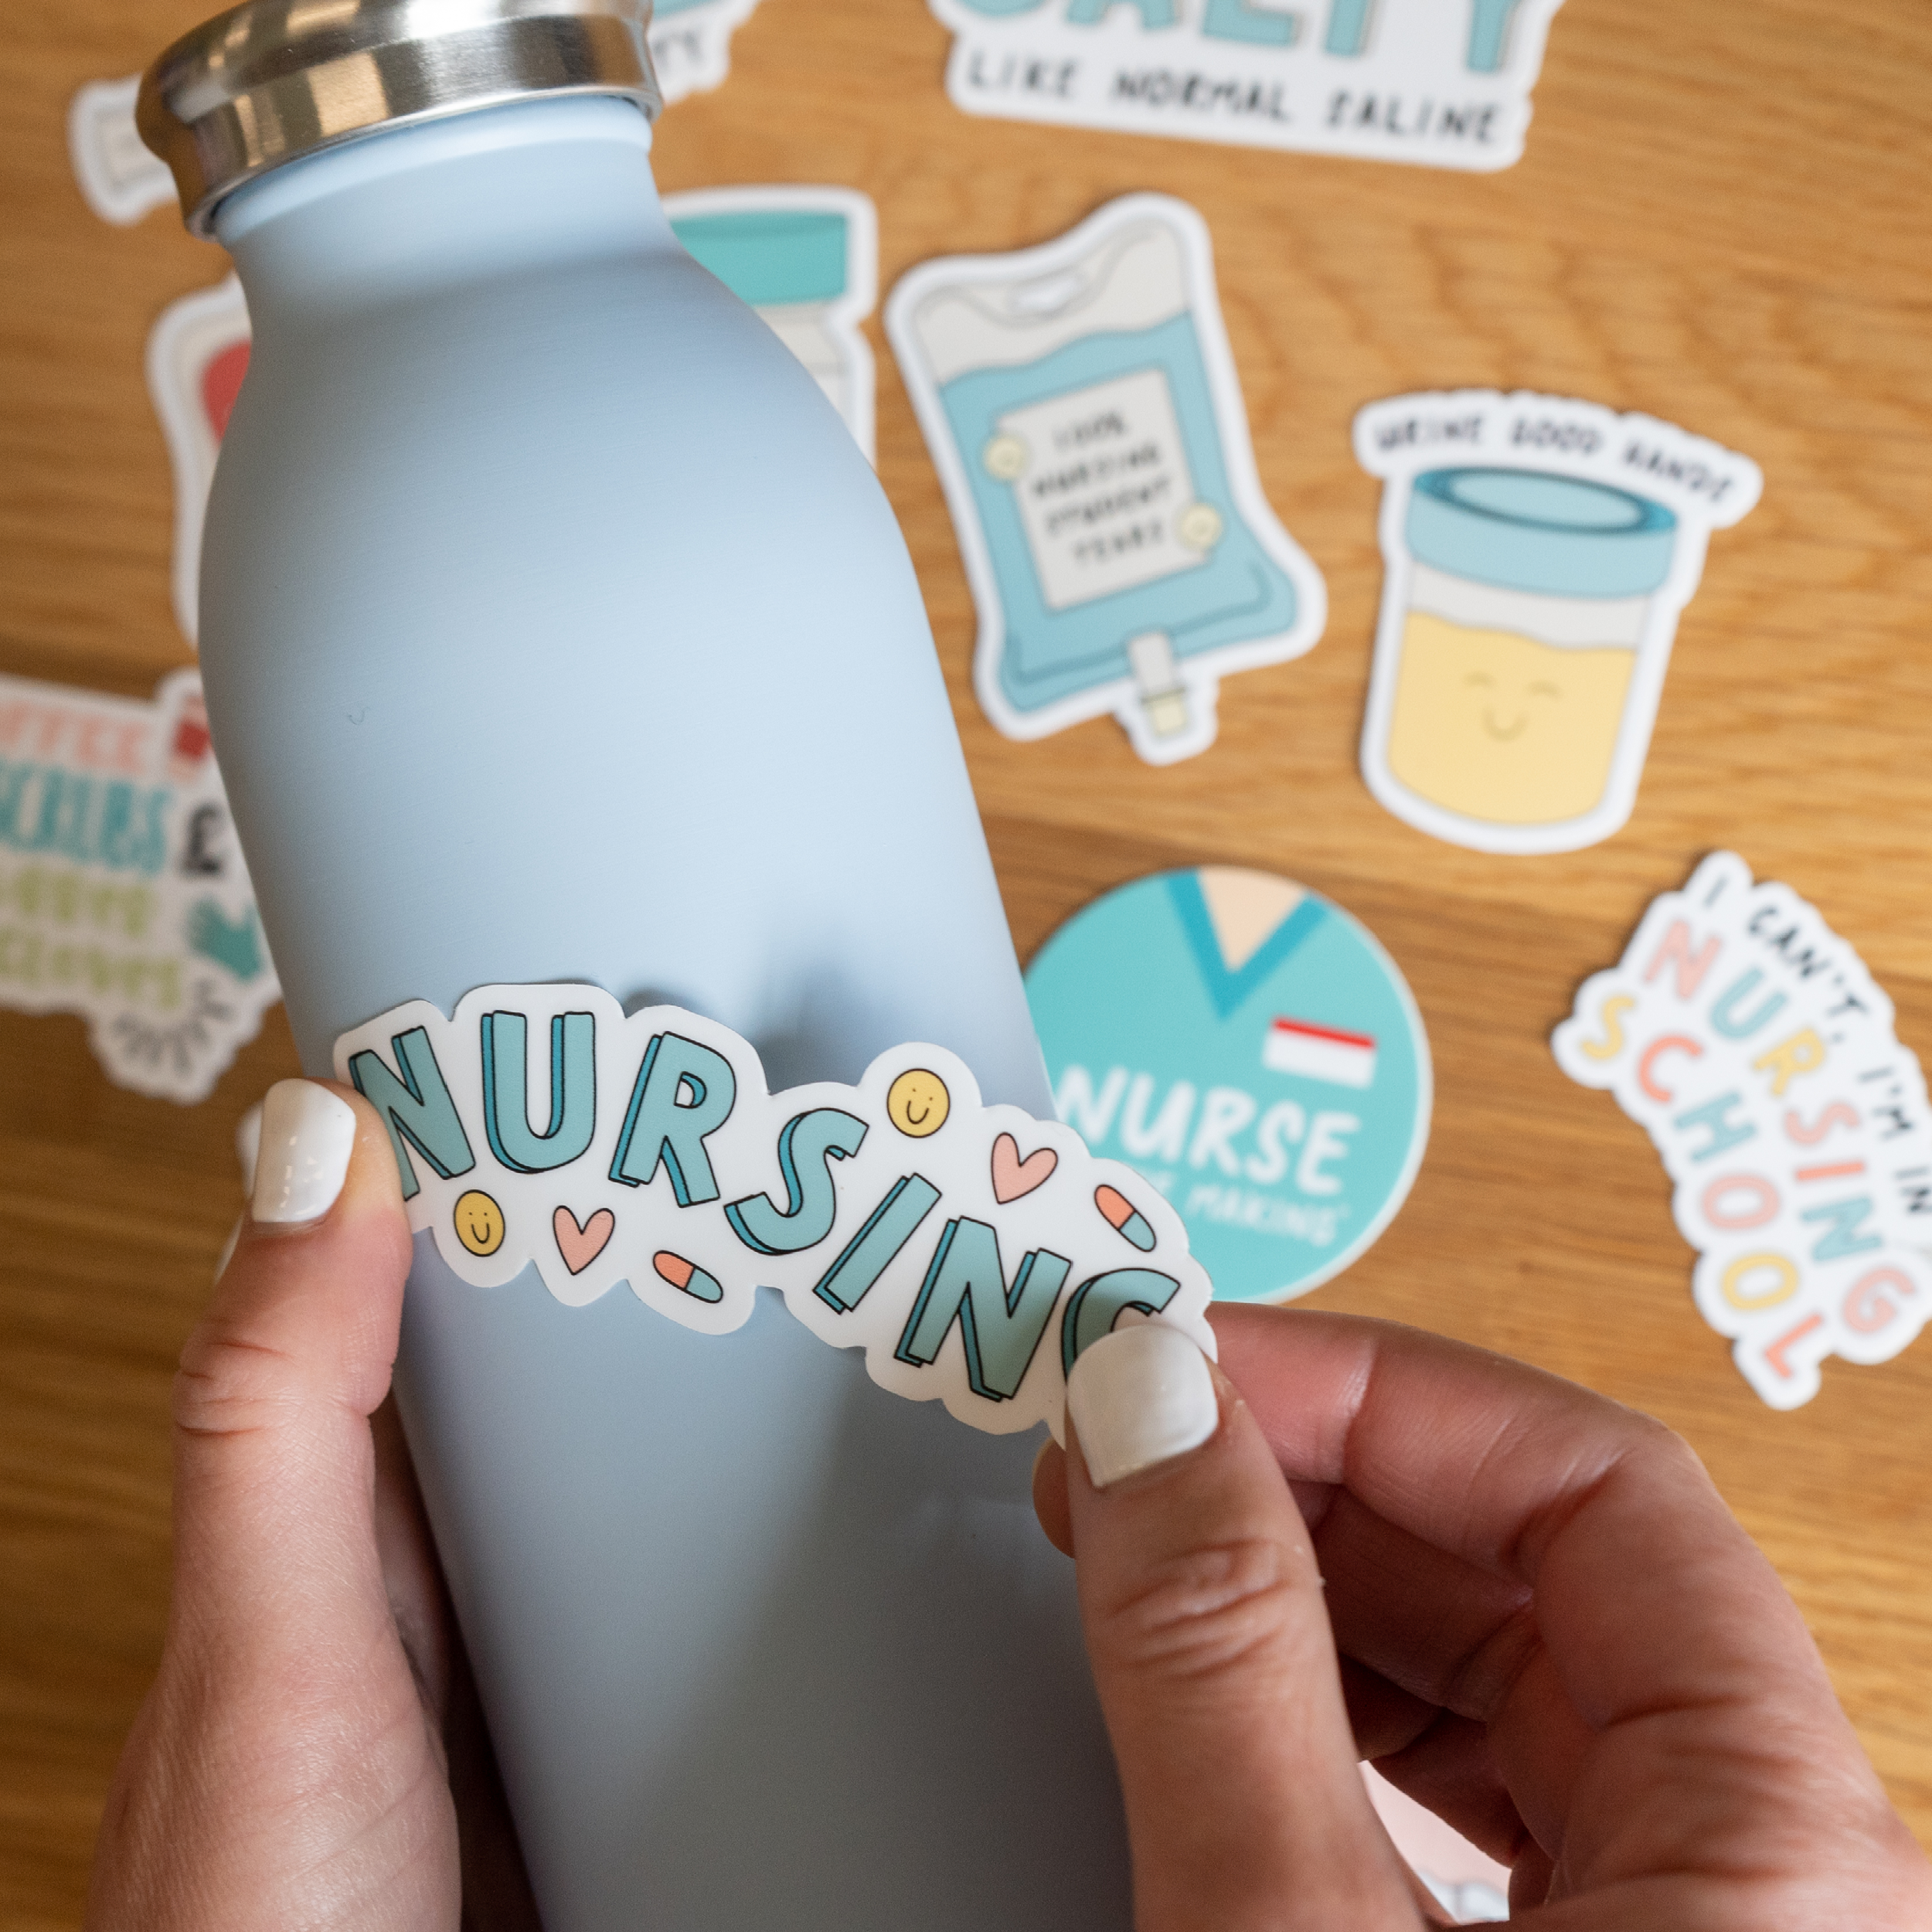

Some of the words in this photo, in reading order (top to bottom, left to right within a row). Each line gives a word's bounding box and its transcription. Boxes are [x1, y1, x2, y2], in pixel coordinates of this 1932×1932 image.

[967, 48, 1080, 99] LIKE
[1111, 66, 1291, 124] NORMAL
[1325, 85, 1504, 145] SALINE
[1055, 1063, 1362, 1198] NURSE
[1580, 995, 1825, 1380] SCHOOL
[1642, 919, 1917, 1334] NURSING
